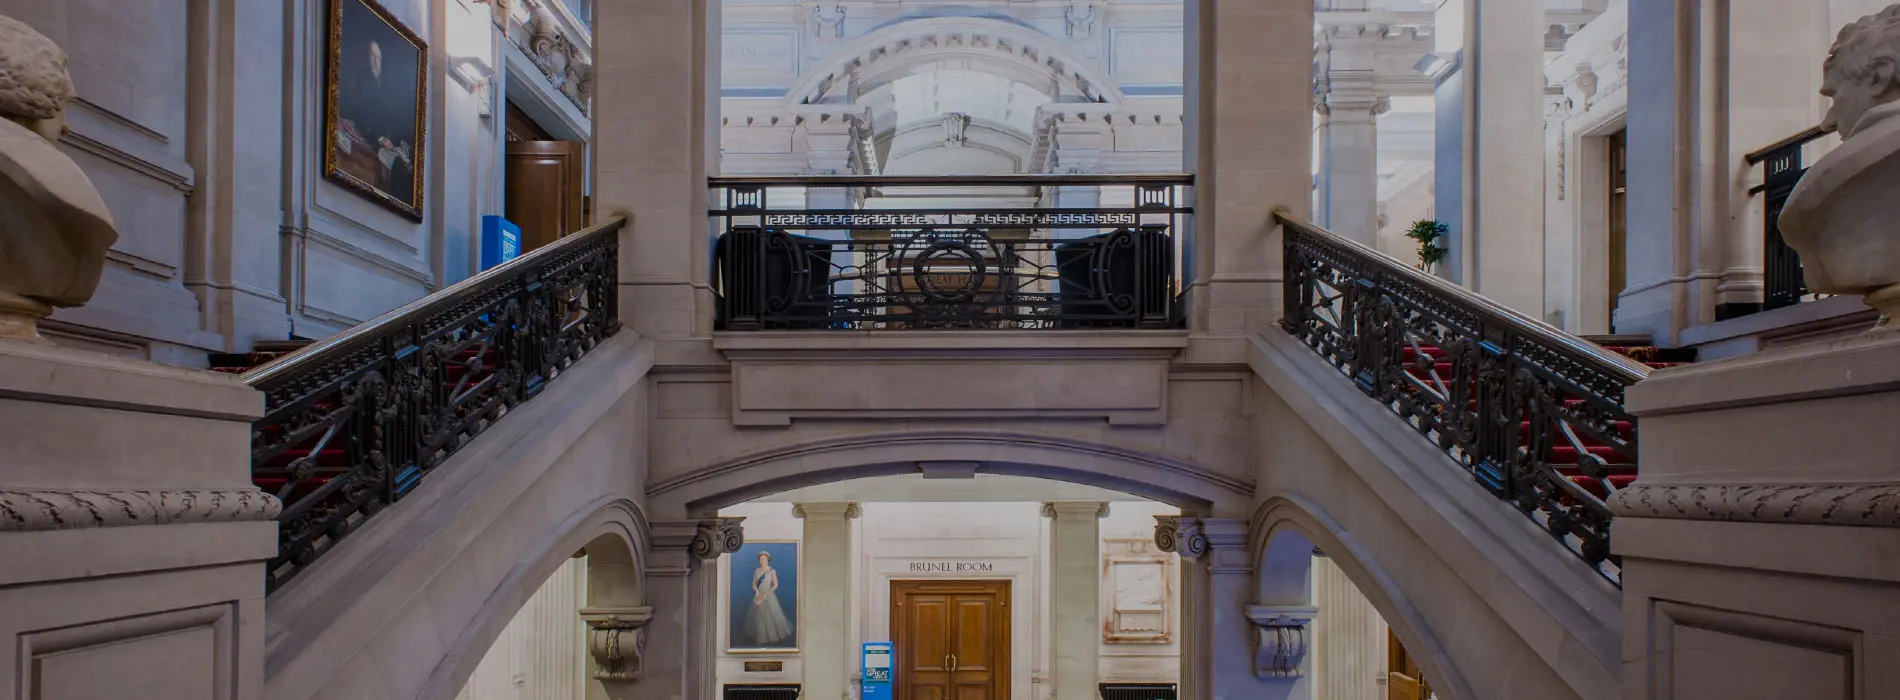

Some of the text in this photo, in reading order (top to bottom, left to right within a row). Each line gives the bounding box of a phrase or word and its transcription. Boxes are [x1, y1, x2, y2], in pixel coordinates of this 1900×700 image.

[924, 275, 952, 285] REAT
[910, 562, 992, 572] BRUNEL ROOM
